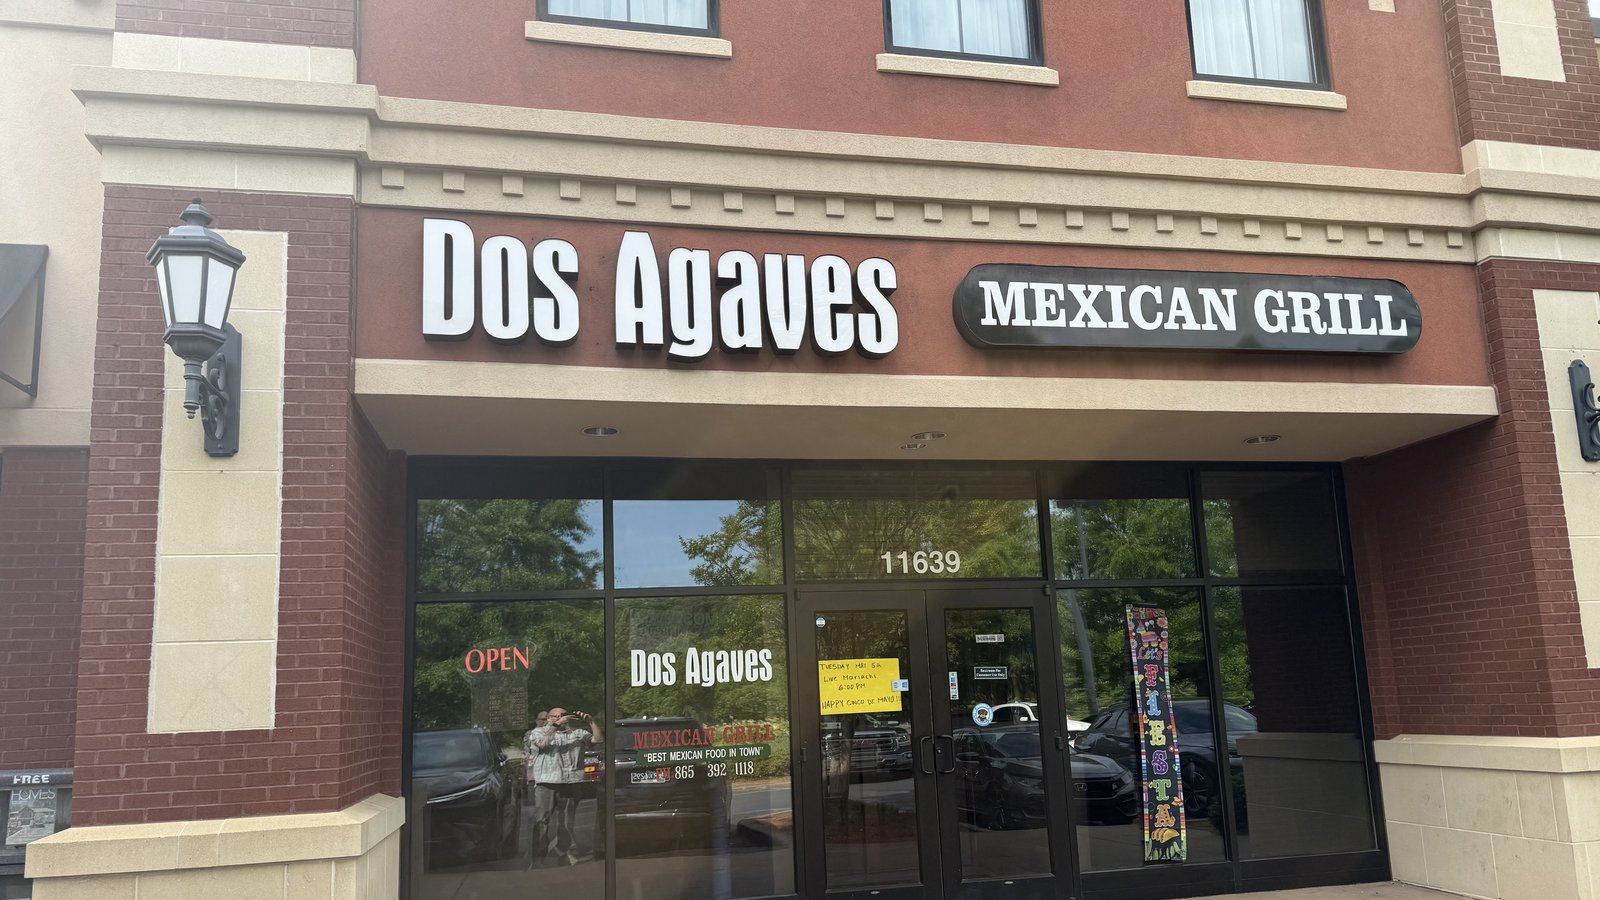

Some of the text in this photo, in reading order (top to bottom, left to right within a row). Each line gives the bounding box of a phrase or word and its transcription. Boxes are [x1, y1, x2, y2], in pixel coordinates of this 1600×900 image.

[422, 218, 899, 358] Dos Agaves
[978, 279, 1408, 337] MEXICAN GRILL
[880, 550, 961, 574] 11639
[465, 646, 529, 673] OPEN
[630, 647, 773, 687] Dos Agaves
[843, 673, 877, 681] Mariachi
[821, 700, 844, 710] HAPPY
[633, 724, 776, 750] MEXICAN GRILL
[1144, 664, 1176, 828] FIESTA
[670, 750, 703, 761] MEXICAN
[705, 748, 727, 759] FOOD
[729, 748, 737, 757] IN
[13, 774, 50, 784] FREE
[674, 765, 694, 779] 865
[707, 763, 727, 778] 392
[735, 760, 754, 775] 1118
